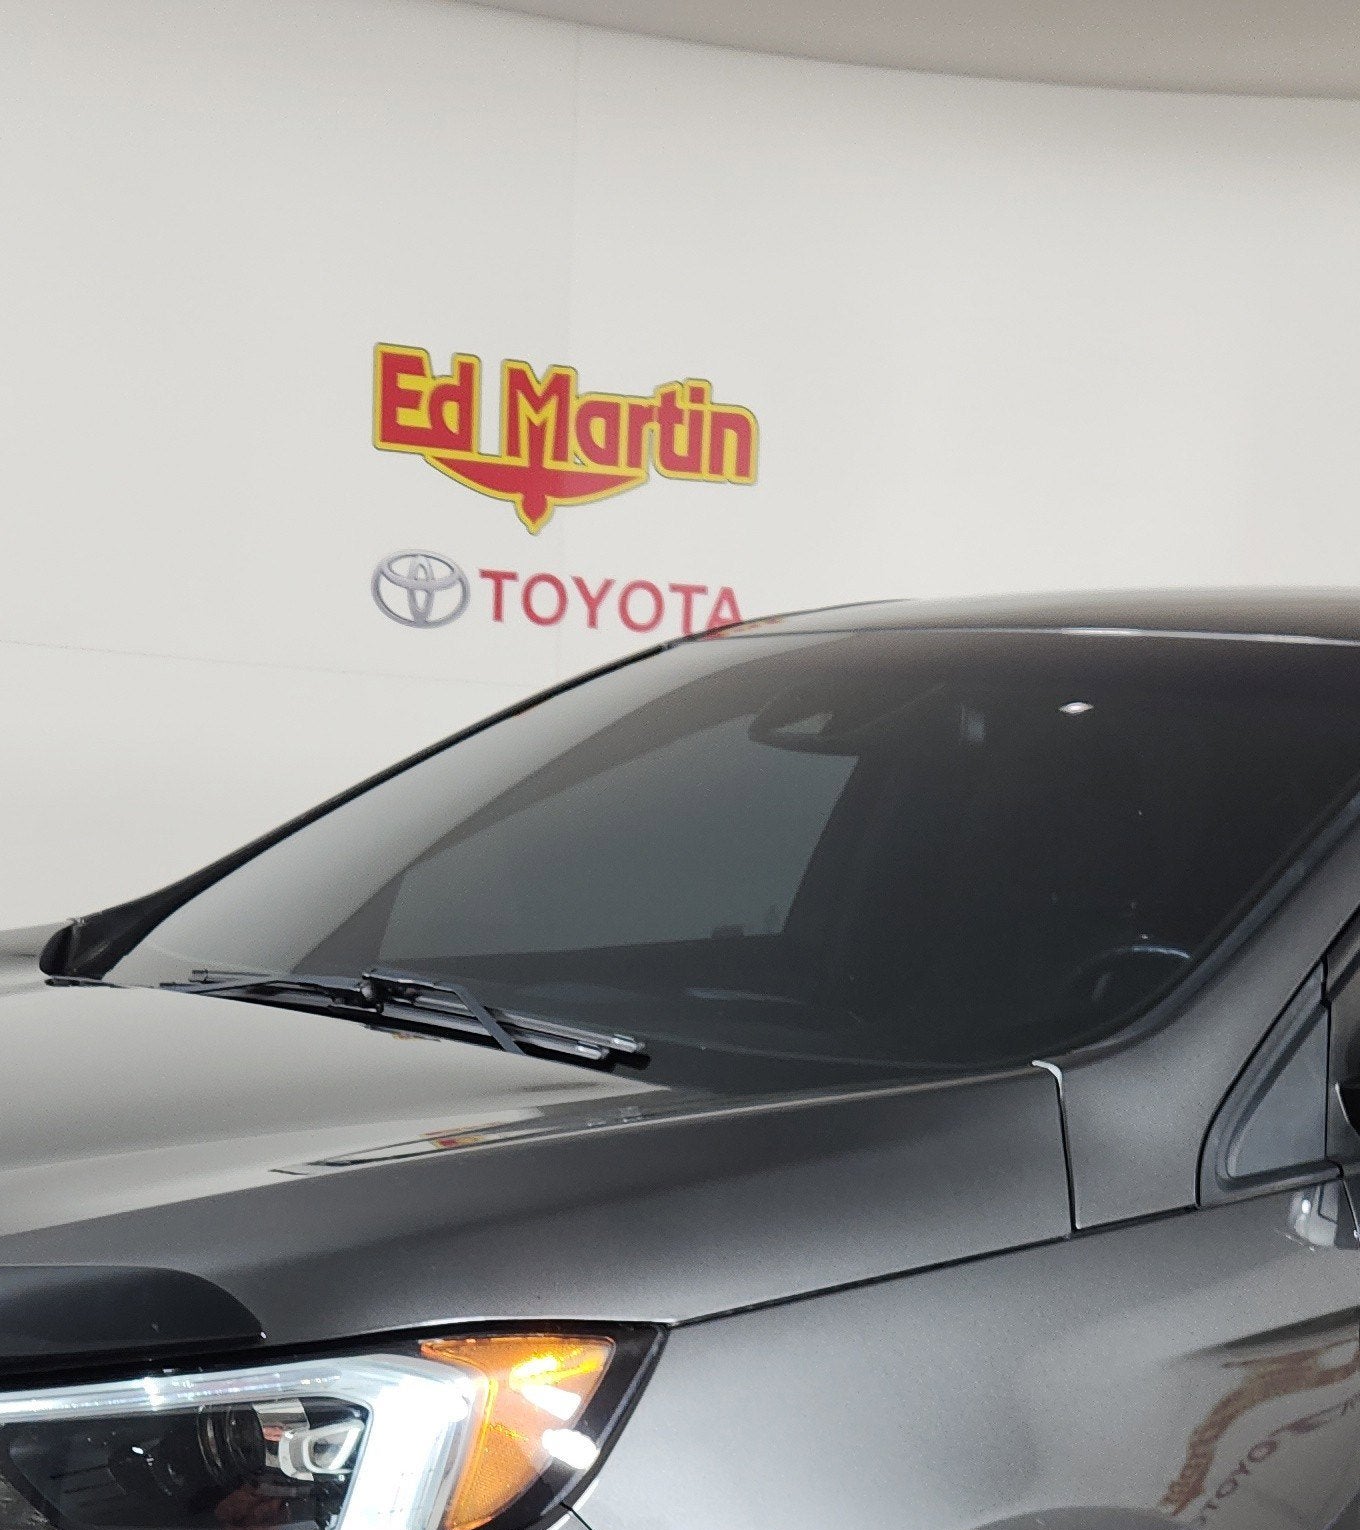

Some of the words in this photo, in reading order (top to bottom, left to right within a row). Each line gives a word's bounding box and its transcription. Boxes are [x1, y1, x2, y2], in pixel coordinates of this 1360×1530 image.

[375, 345, 479, 453] Ed
[503, 361, 757, 482] Martin
[478, 568, 746, 638] TOYOTA
